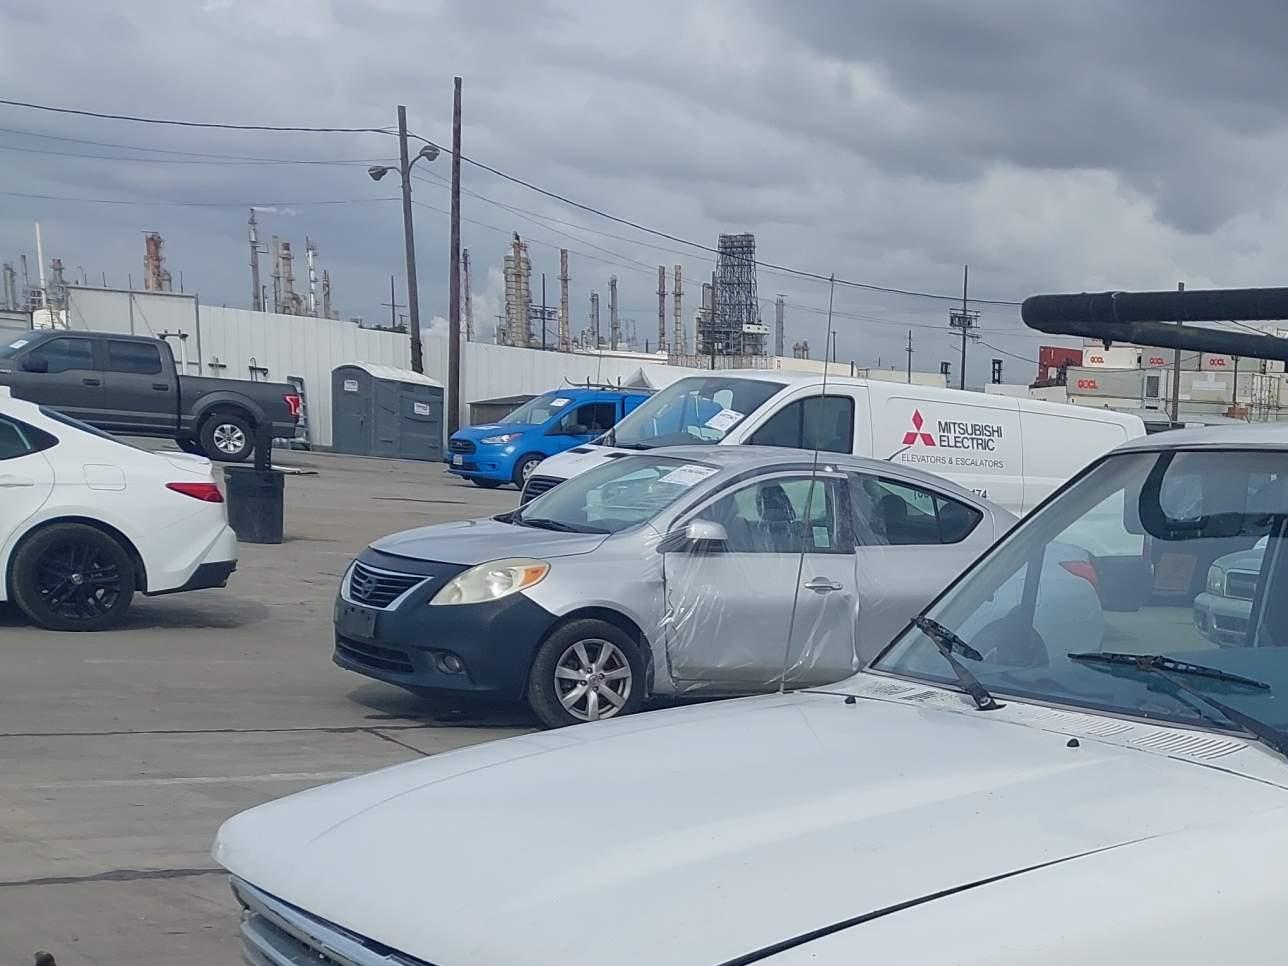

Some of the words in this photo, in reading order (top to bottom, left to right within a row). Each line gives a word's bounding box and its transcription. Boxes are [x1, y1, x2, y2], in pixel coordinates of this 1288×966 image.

[1077, 379, 1098, 389] OOCL
[937, 421, 1003, 438] MITSUBISHI
[940, 435, 995, 451] ELECTRIC
[901, 454, 946, 465] ELEVATORS
[955, 458, 1004, 468] ESCALATORS
